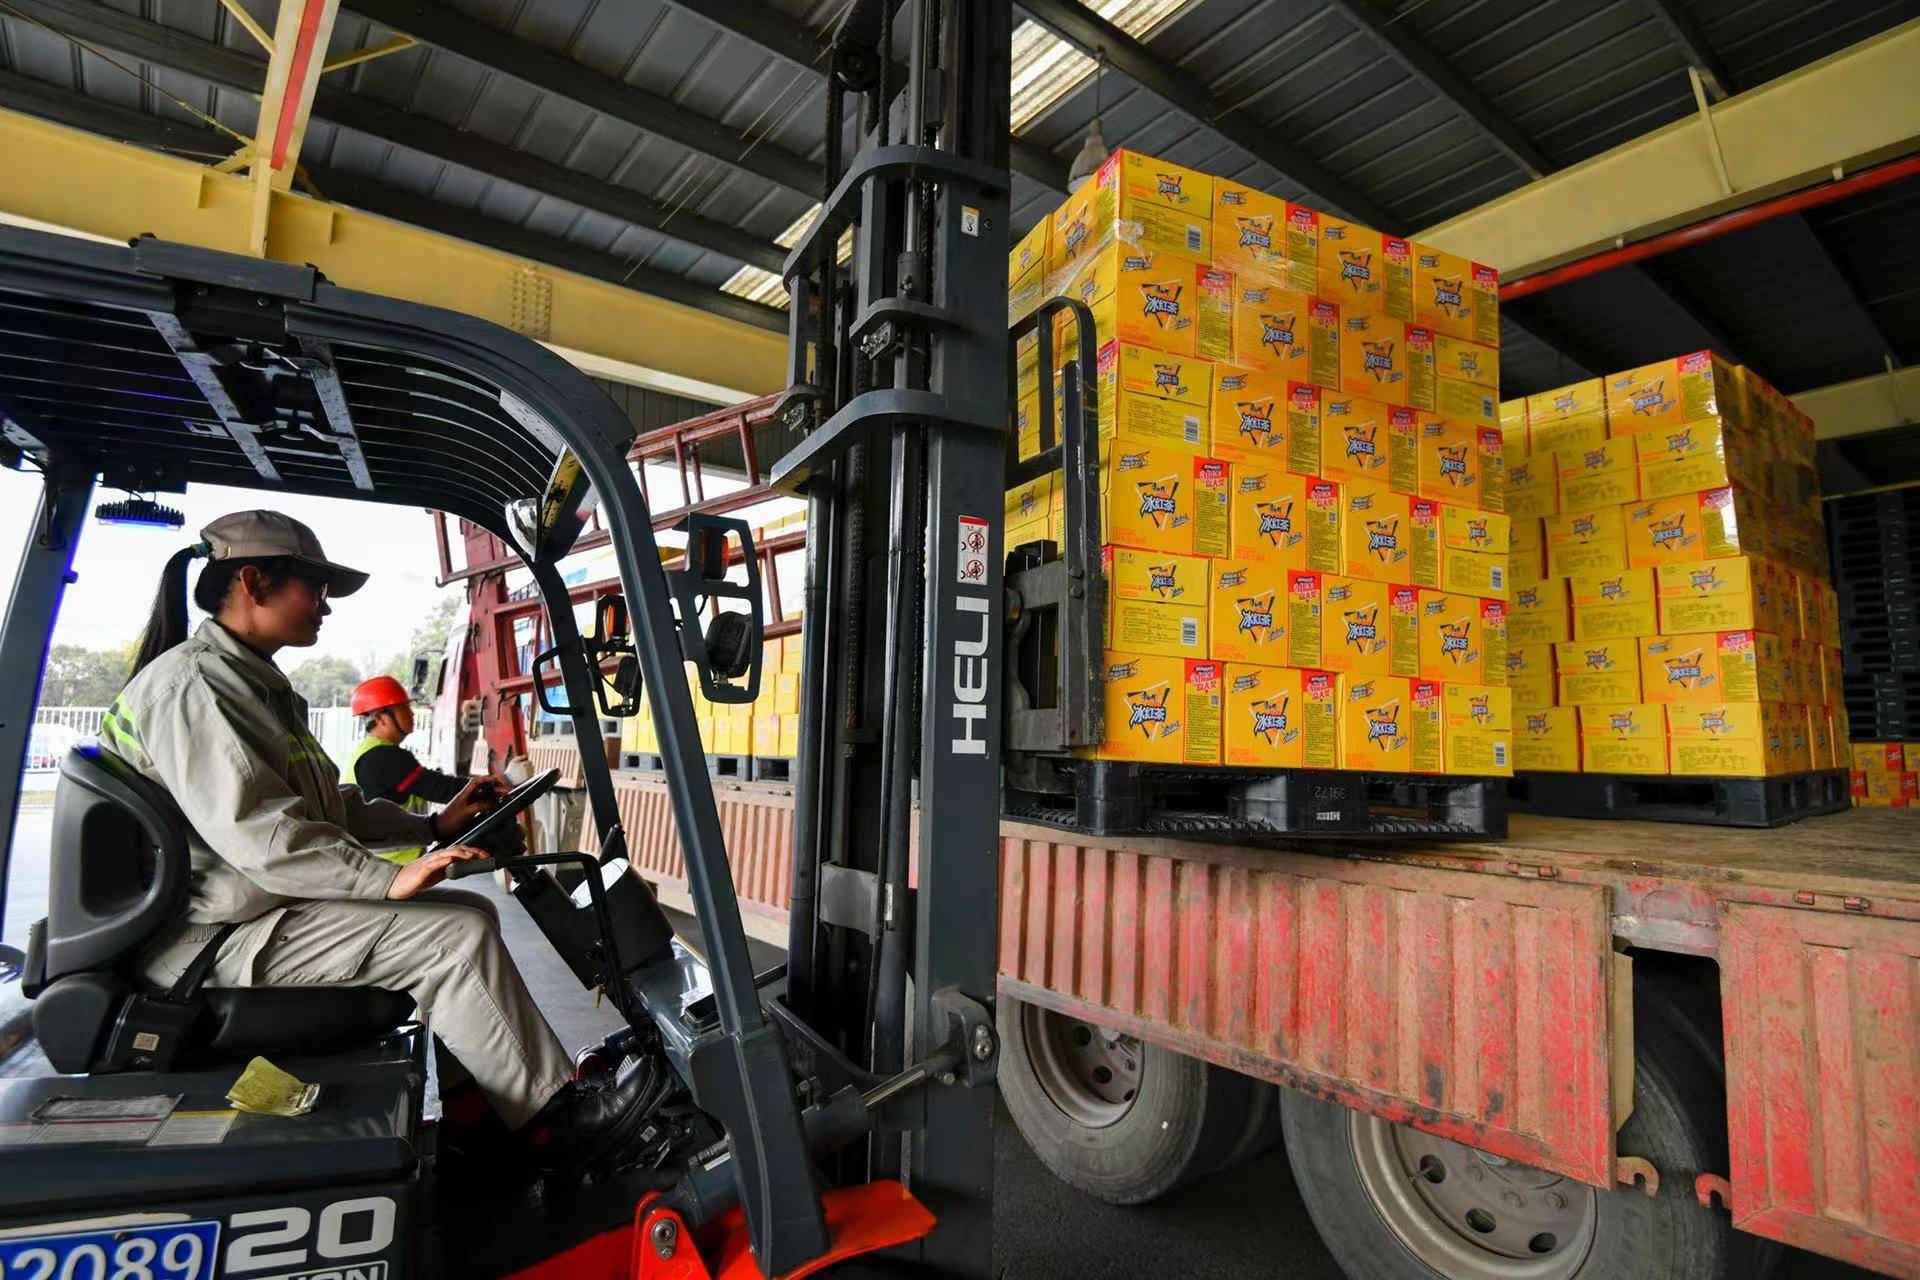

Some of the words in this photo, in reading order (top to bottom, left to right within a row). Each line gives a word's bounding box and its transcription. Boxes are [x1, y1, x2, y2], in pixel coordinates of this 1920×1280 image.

[1141, 494, 1175, 514] 冰红茶
[1239, 610, 1272, 630] 冰红茶
[952, 596, 989, 754] HELI
[1130, 704, 1166, 725] 冰红茶
[1253, 714, 1286, 733] 冰红茶
[225, 1196, 396, 1273] 20
[0, 1233, 203, 1280] 2089
